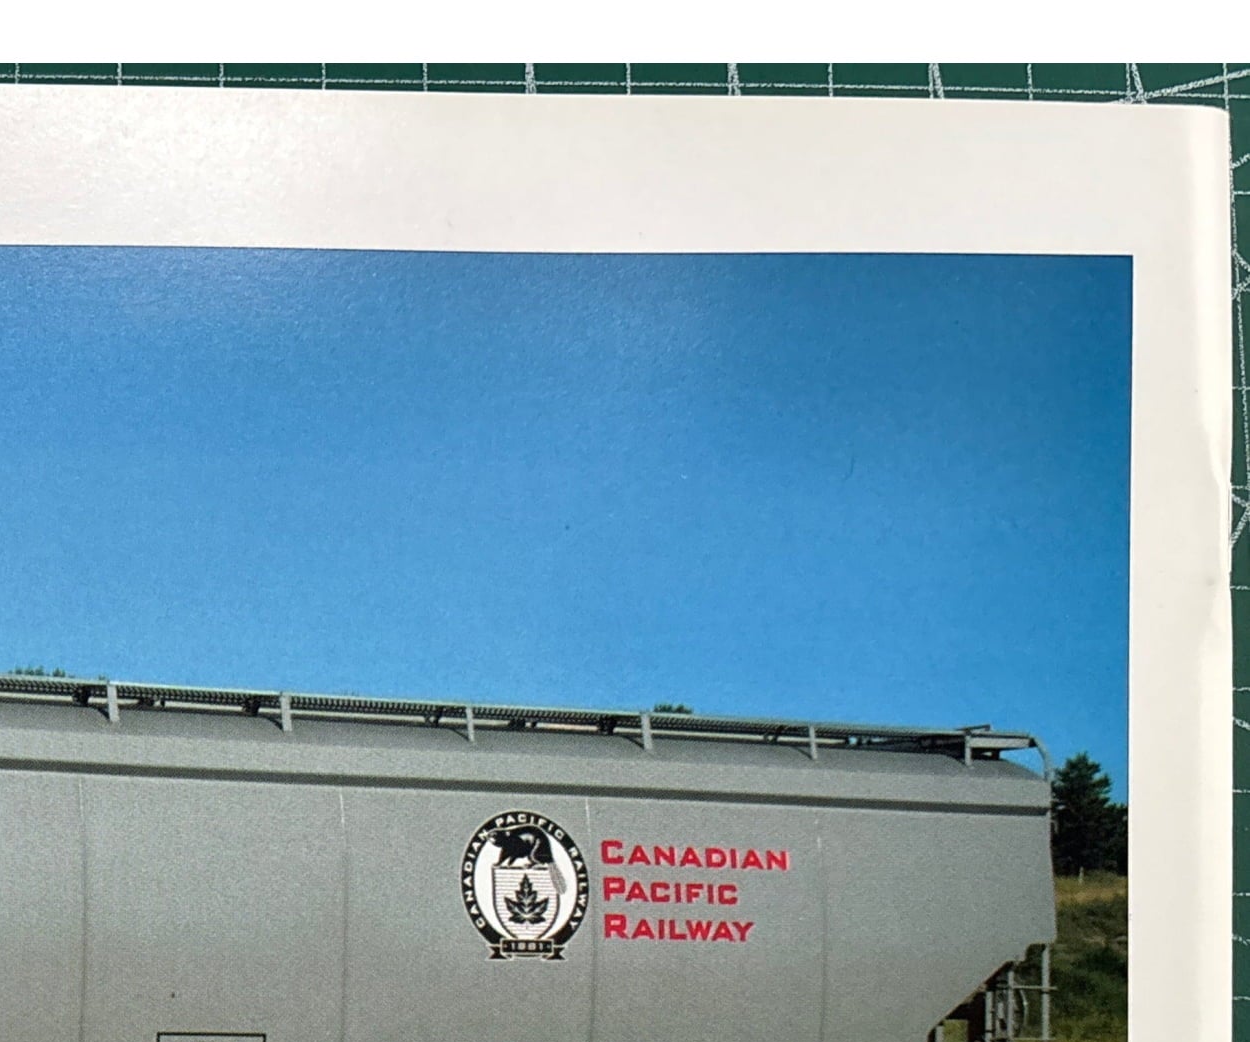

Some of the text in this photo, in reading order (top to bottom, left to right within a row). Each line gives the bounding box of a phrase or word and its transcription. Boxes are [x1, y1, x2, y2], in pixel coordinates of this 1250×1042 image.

[600, 839, 790, 871] CANADIAN
[463, 814, 587, 930] CANADIAN PACIFIC RAILWAY
[602, 876, 738, 905] PACIFIC
[604, 913, 755, 942] RAILWAY
